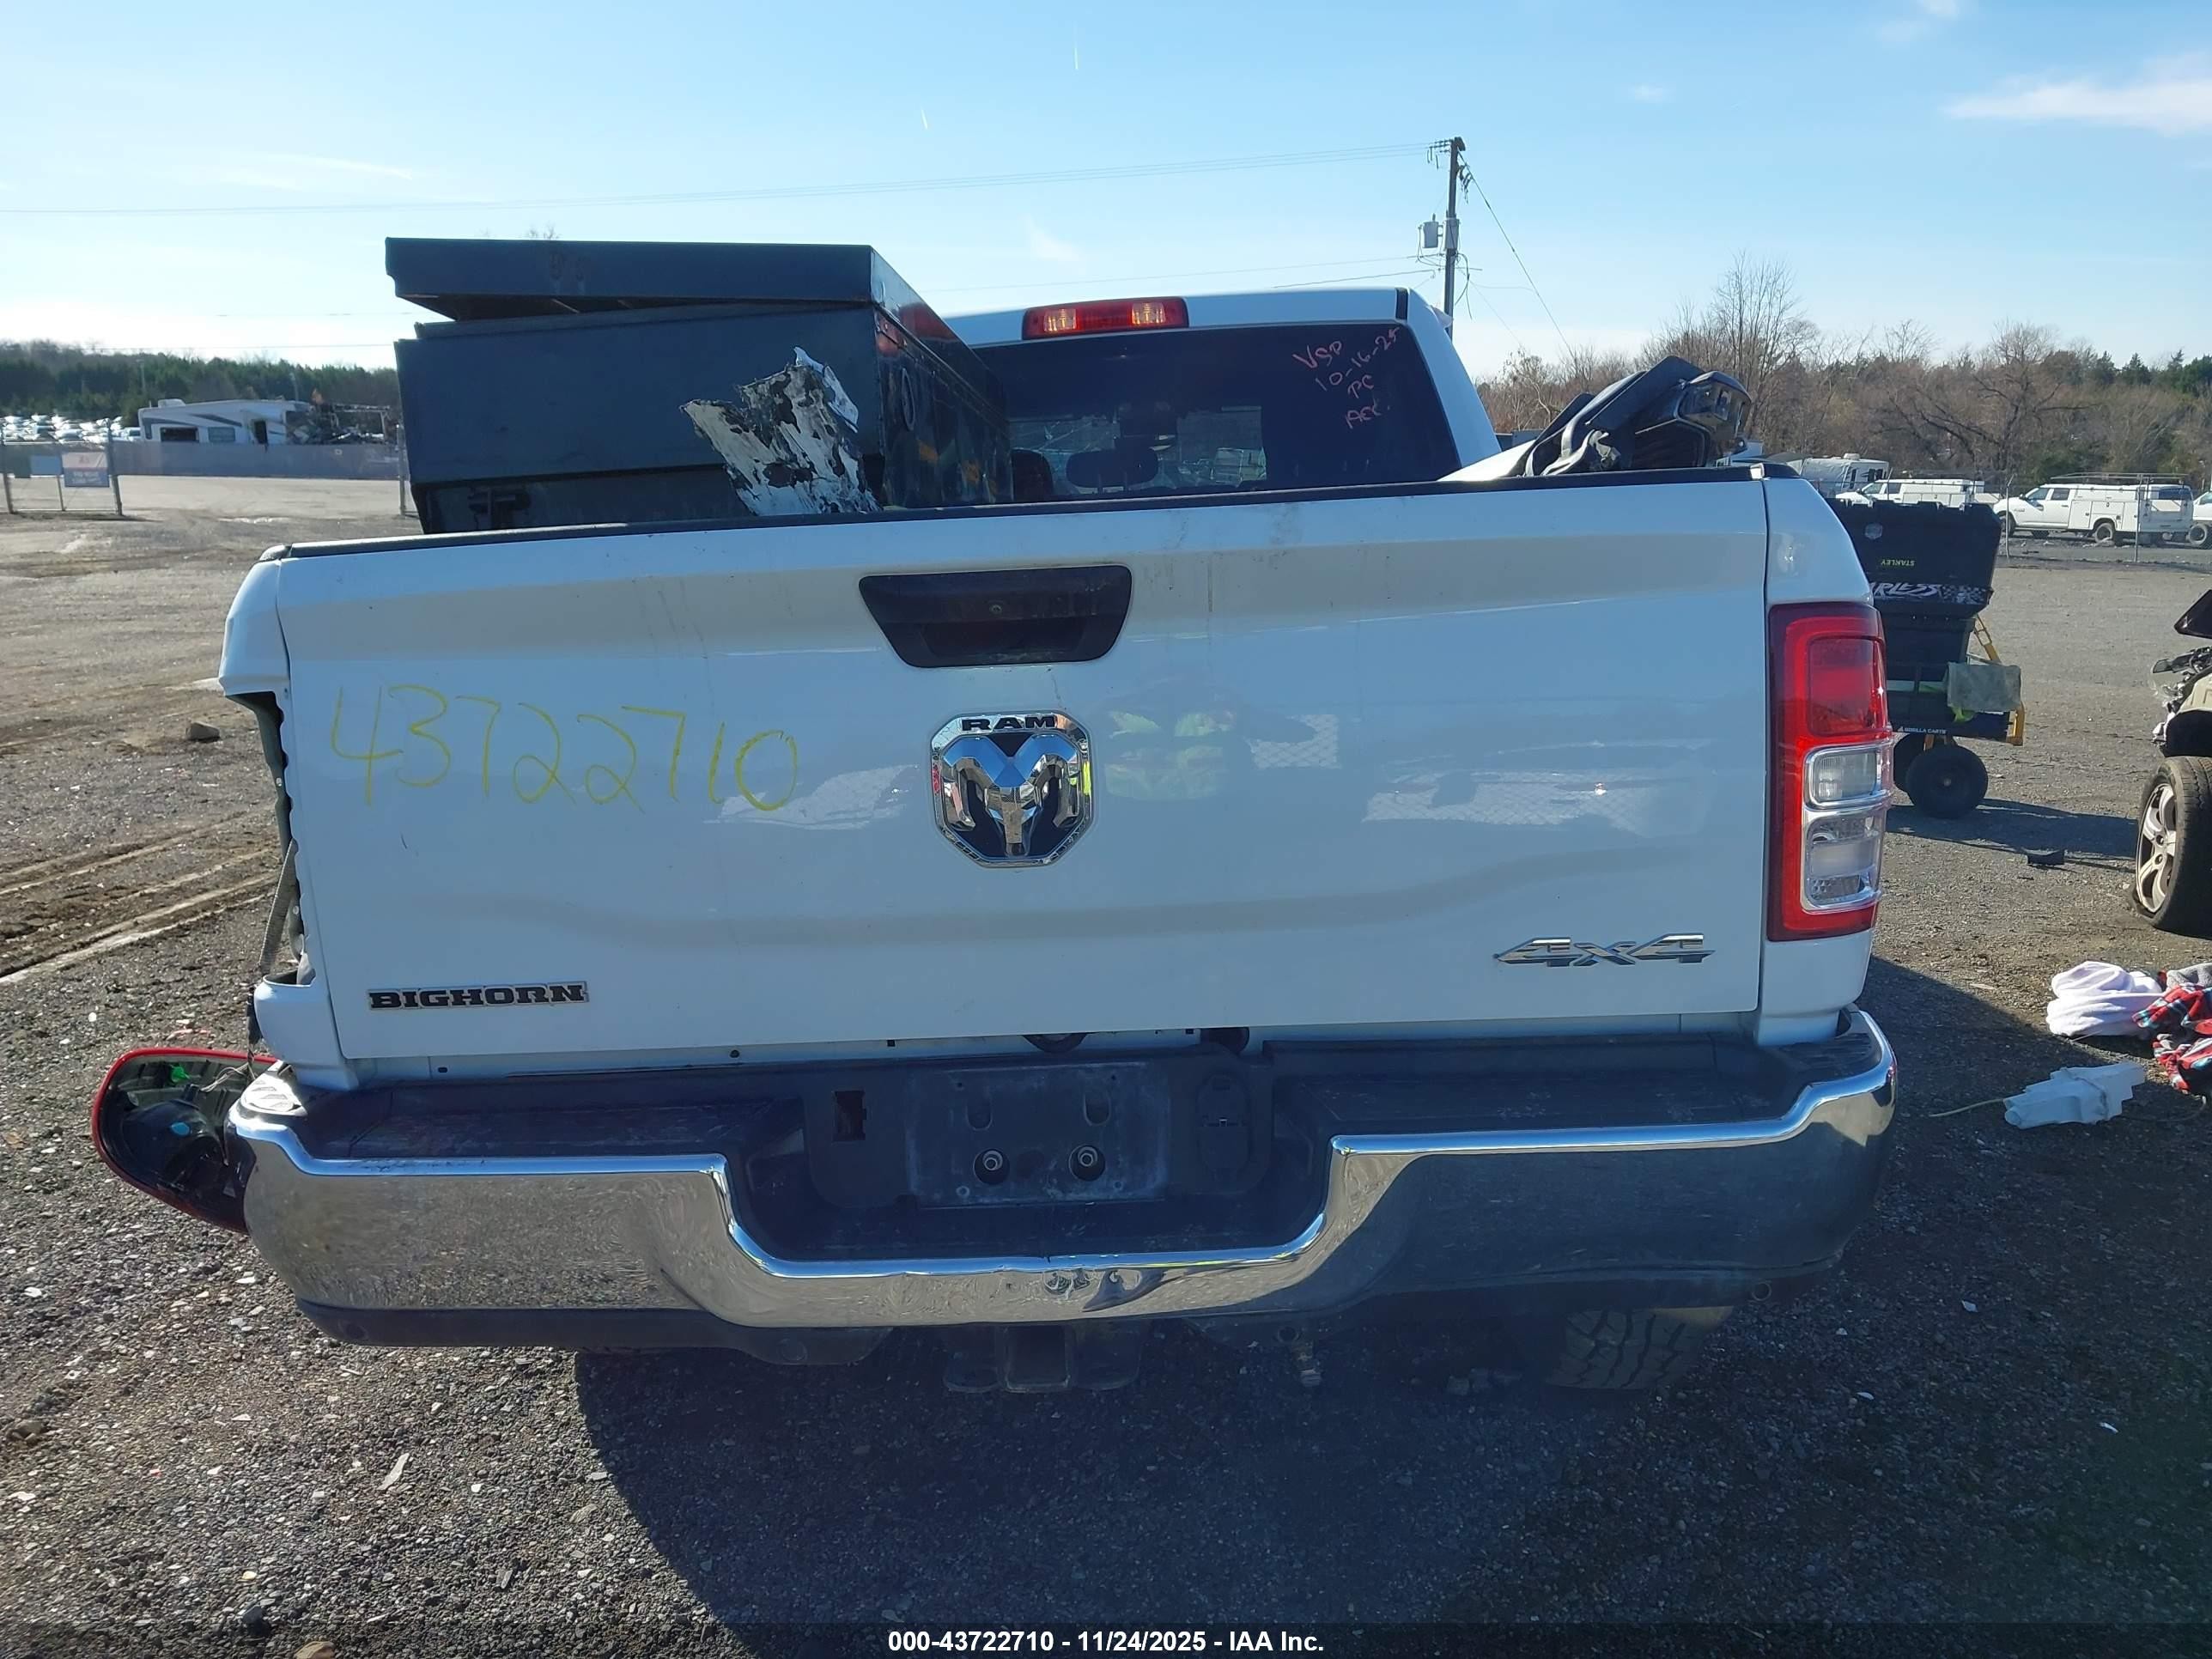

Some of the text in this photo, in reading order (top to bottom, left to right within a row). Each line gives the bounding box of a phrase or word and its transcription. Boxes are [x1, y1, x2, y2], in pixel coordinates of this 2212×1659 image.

[1315, 326, 1401, 392] 10-16-25
[961, 715, 1055, 731] RAM
[330, 684, 798, 813] 43722710
[367, 981, 589, 1010] BIGHORN
